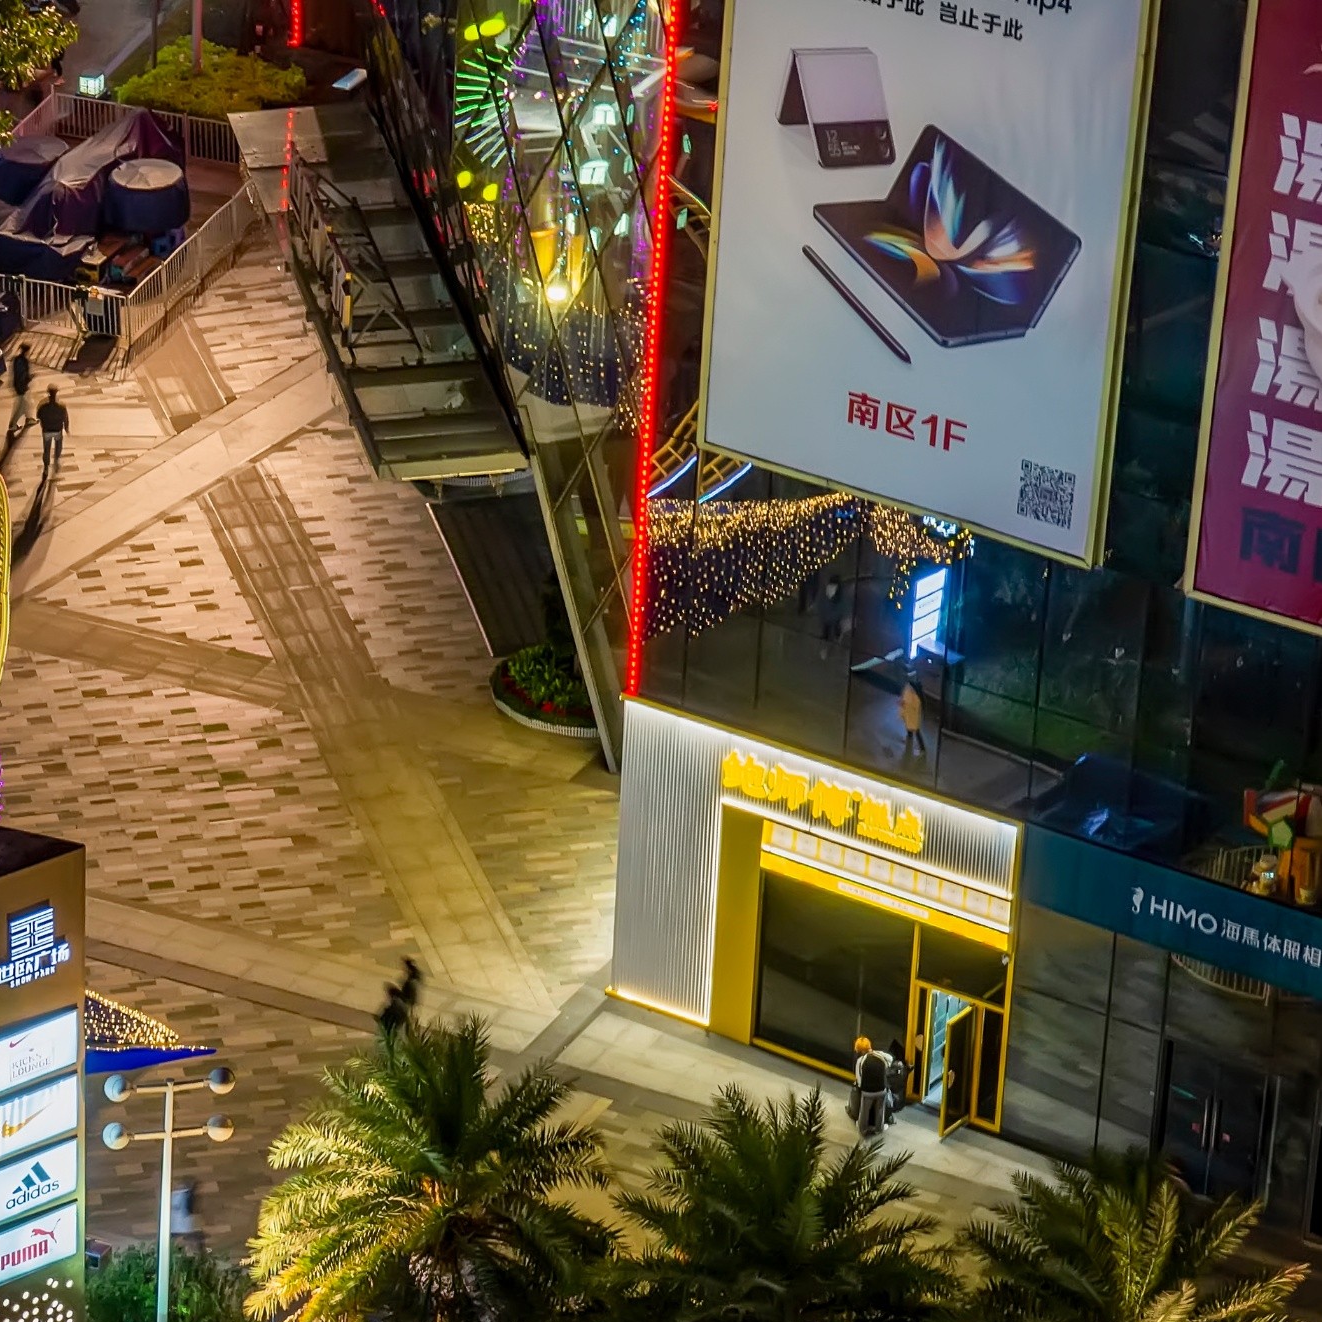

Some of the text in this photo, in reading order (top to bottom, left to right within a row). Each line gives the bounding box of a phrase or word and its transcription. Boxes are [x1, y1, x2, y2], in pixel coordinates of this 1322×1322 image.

[939, 2, 1024, 41] 岂止于此
[847, 391, 968, 451] 南区1F
[1150, 895, 1218, 935] HIMO
[34, 965, 56, 980] PARK
[12, 1057, 52, 1079] LOUNGE
[5, 1180, 60, 1210] adidas
[0, 1239, 49, 1271] PUMA
